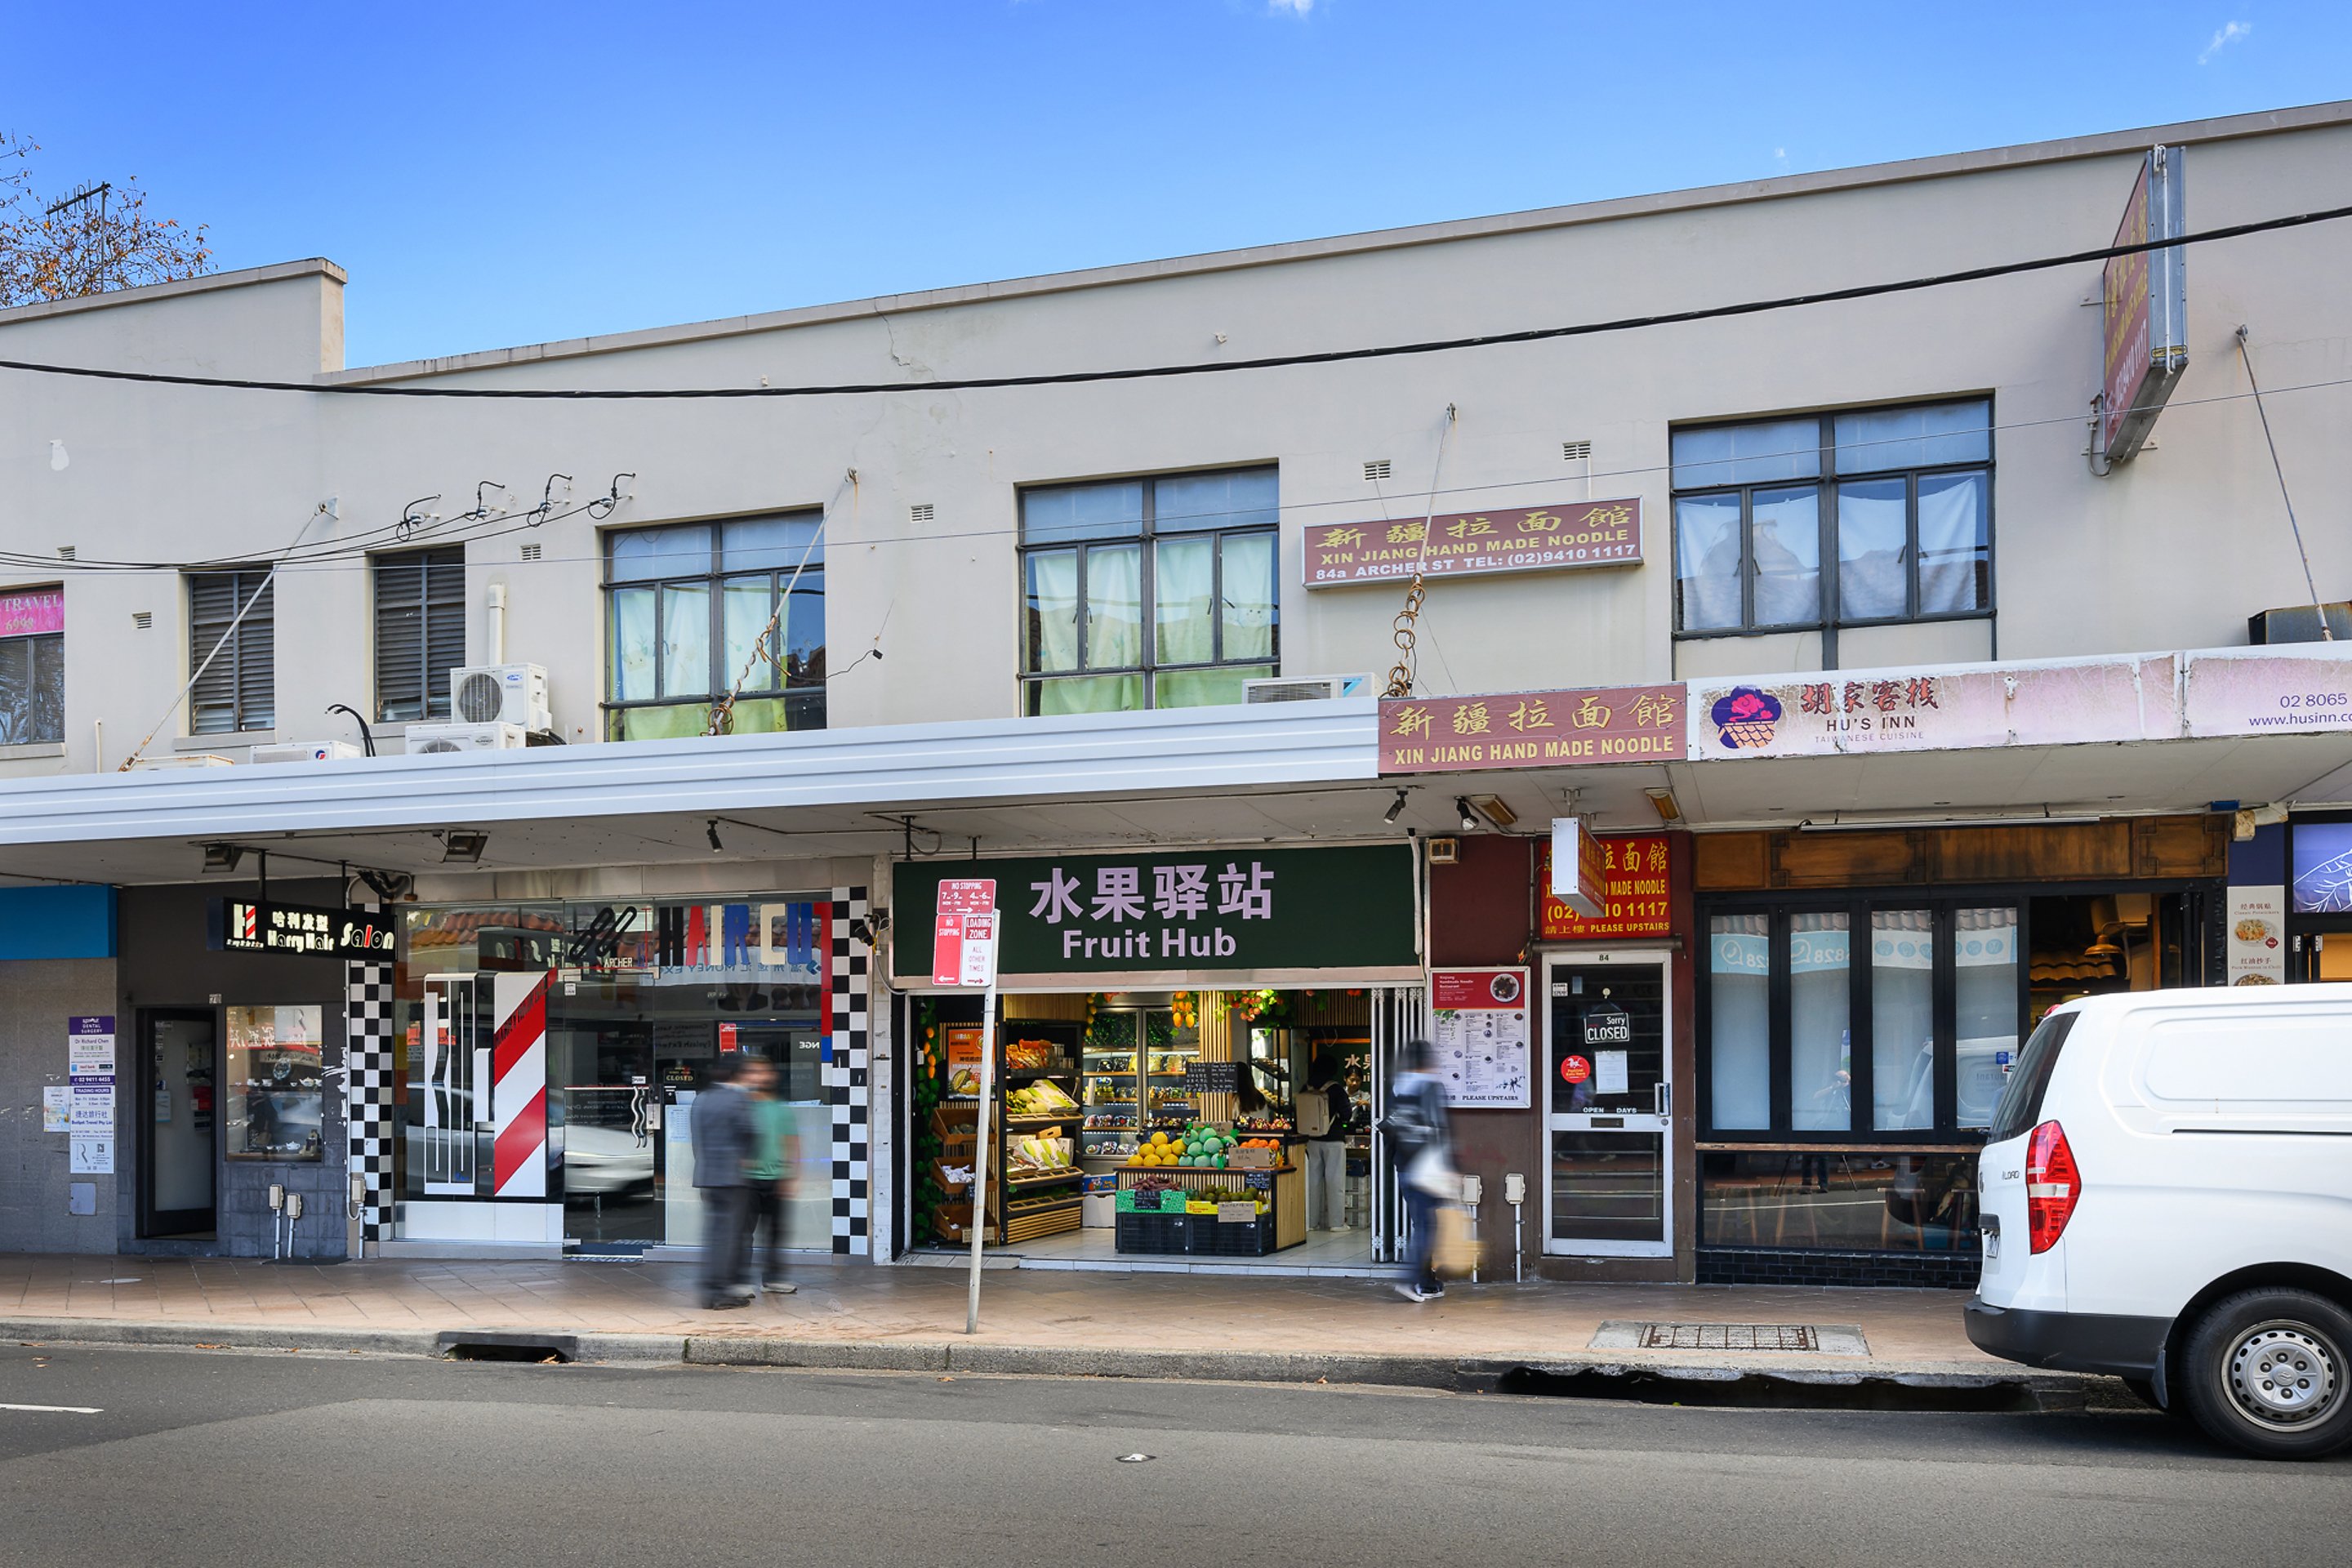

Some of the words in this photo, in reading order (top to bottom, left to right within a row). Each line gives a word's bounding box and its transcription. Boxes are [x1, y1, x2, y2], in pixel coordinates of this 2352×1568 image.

[1321, 552, 1353, 565] XIN
[1361, 547, 1418, 562] JIANG
[1426, 542, 1478, 556] HAND
[1486, 537, 1539, 551] MADE
[1548, 530, 1628, 546] NOODLE
[1316, 569, 1347, 580] 84a
[1355, 562, 1428, 577] ARCHER
[1432, 559, 1454, 570] ST
[1463, 556, 1503, 568] TEL:
[1592, 544, 1636, 558] 1117
[2, 595, 62, 612] TRAVEL
[2279, 695, 2301, 708] 02
[2305, 693, 2348, 706] 8065
[1826, 718, 1871, 732] HU'S
[1882, 715, 1915, 729] INN
[1815, 733, 1874, 744] TAIWANESE
[1879, 731, 1924, 741] CUISINE
[1394, 748, 1424, 765] XIN
[1430, 745, 1483, 764] JIANG
[1490, 742, 1538, 760] HAND
[1545, 740, 1593, 758] MADE
[1601, 736, 1674, 755] NOODLE
[1028, 862, 1275, 924] 水果驿站
[1610, 880, 1632, 895] MADE
[1634, 879, 1666, 895] NOODLE
[1548, 905, 1579, 922] (02)
[1605, 903, 1621, 918] 10
[1627, 902, 1668, 917] 1117
[966, 918, 991, 928] LOADING
[1590, 923, 1624, 933] PLEASE
[1627, 921, 1670, 932] UPSTAIRS
[267, 929, 305, 953] Harry
[305, 933, 335, 951] Hair
[340, 922, 395, 950] Salon
[938, 928, 960, 937] STOPPING
[969, 929, 988, 939] ZONE
[1063, 929, 1151, 959] Fruit
[1161, 927, 1236, 958] Hub
[604, 957, 633, 968] ARCHER
[1606, 1016, 1626, 1026] Sorry
[1587, 1027, 1628, 1041] CLOSED
